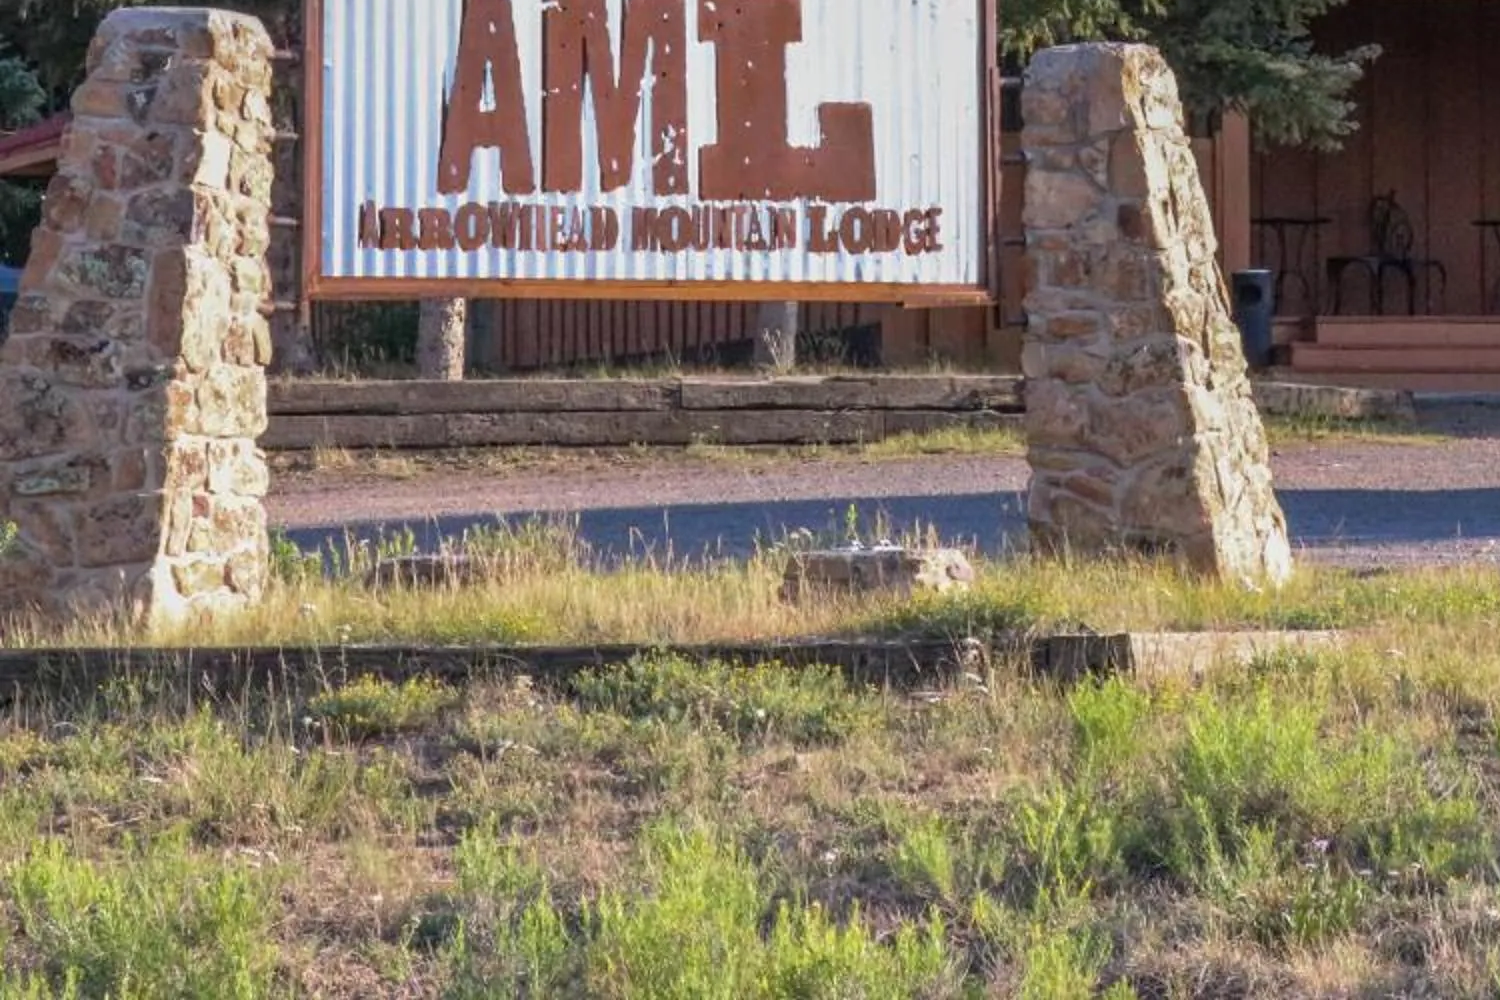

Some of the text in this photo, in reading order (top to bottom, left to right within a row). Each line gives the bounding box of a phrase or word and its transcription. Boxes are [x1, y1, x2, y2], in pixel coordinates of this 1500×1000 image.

[358, 200, 943, 255] ARROWHEAD MOUNTAIN LODGE
